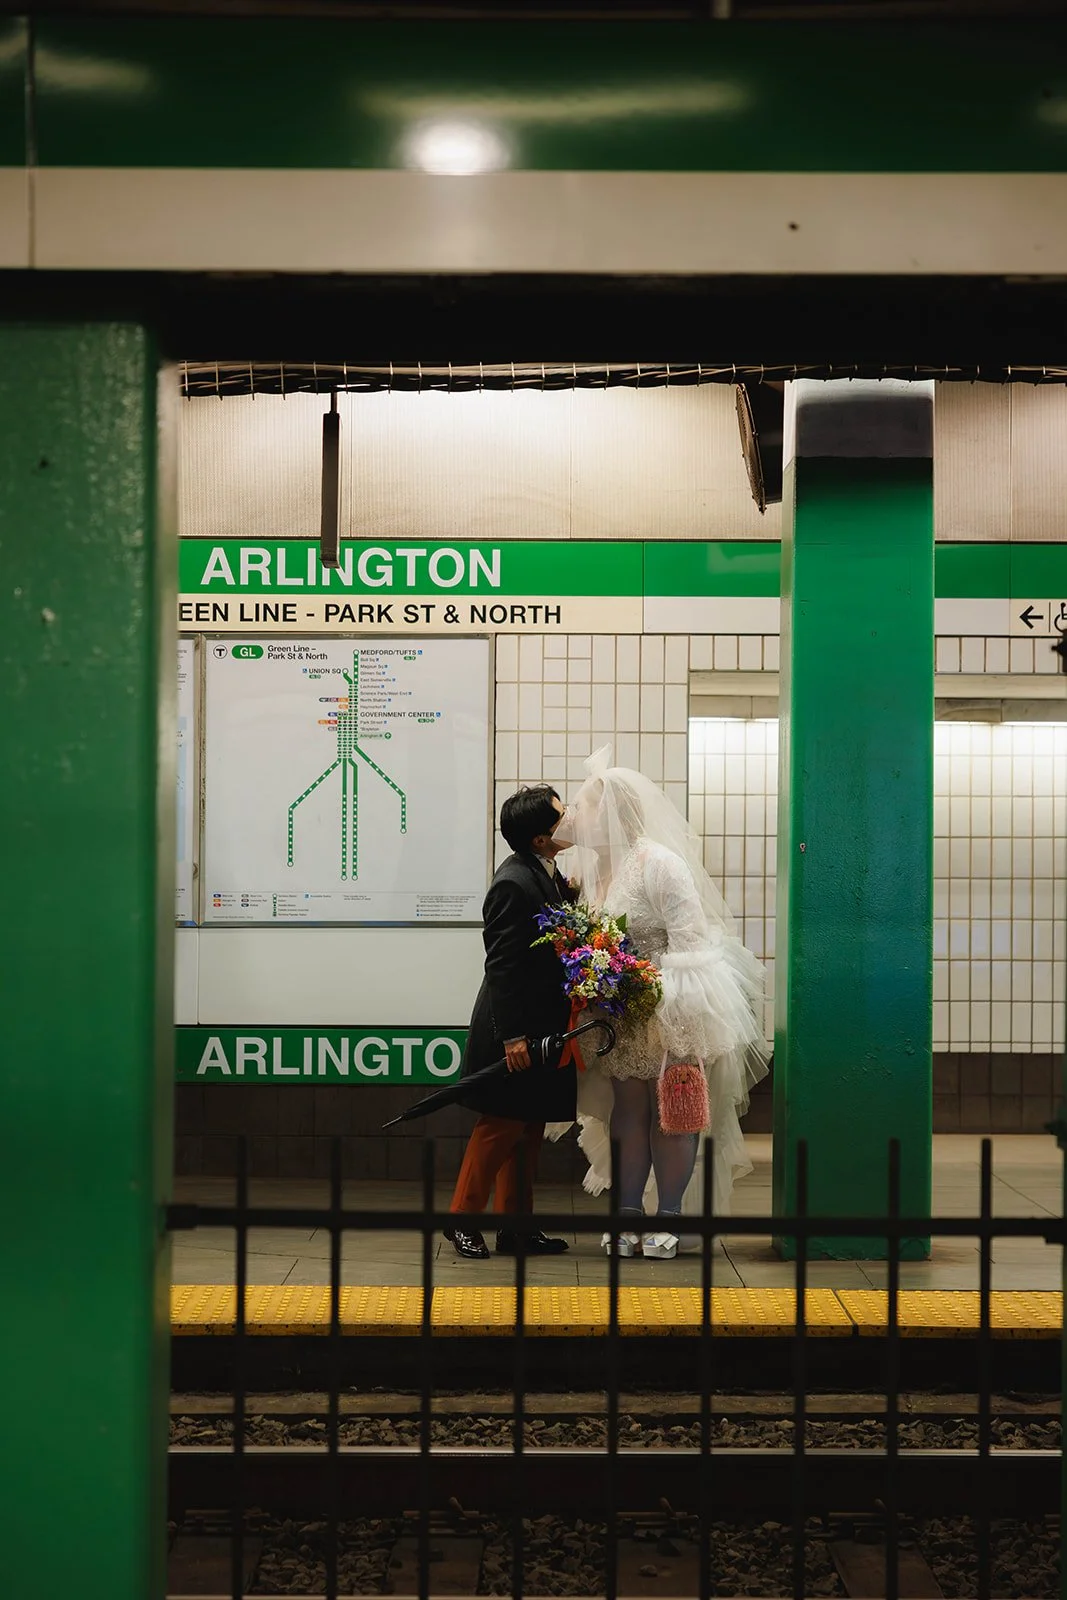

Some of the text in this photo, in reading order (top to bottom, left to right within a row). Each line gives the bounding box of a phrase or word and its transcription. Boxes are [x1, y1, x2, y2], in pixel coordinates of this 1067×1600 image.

[200, 547, 500, 587] ARLINGTON
[179, 603, 229, 622] EEN
[240, 603, 297, 622] LINE
[325, 604, 393, 623] PARK
[403, 604, 435, 623] ST
[443, 604, 460, 624] &
[470, 604, 561, 624] NORTH
[240, 647, 256, 657] GL
[196, 1036, 463, 1077] ARLINGTO
